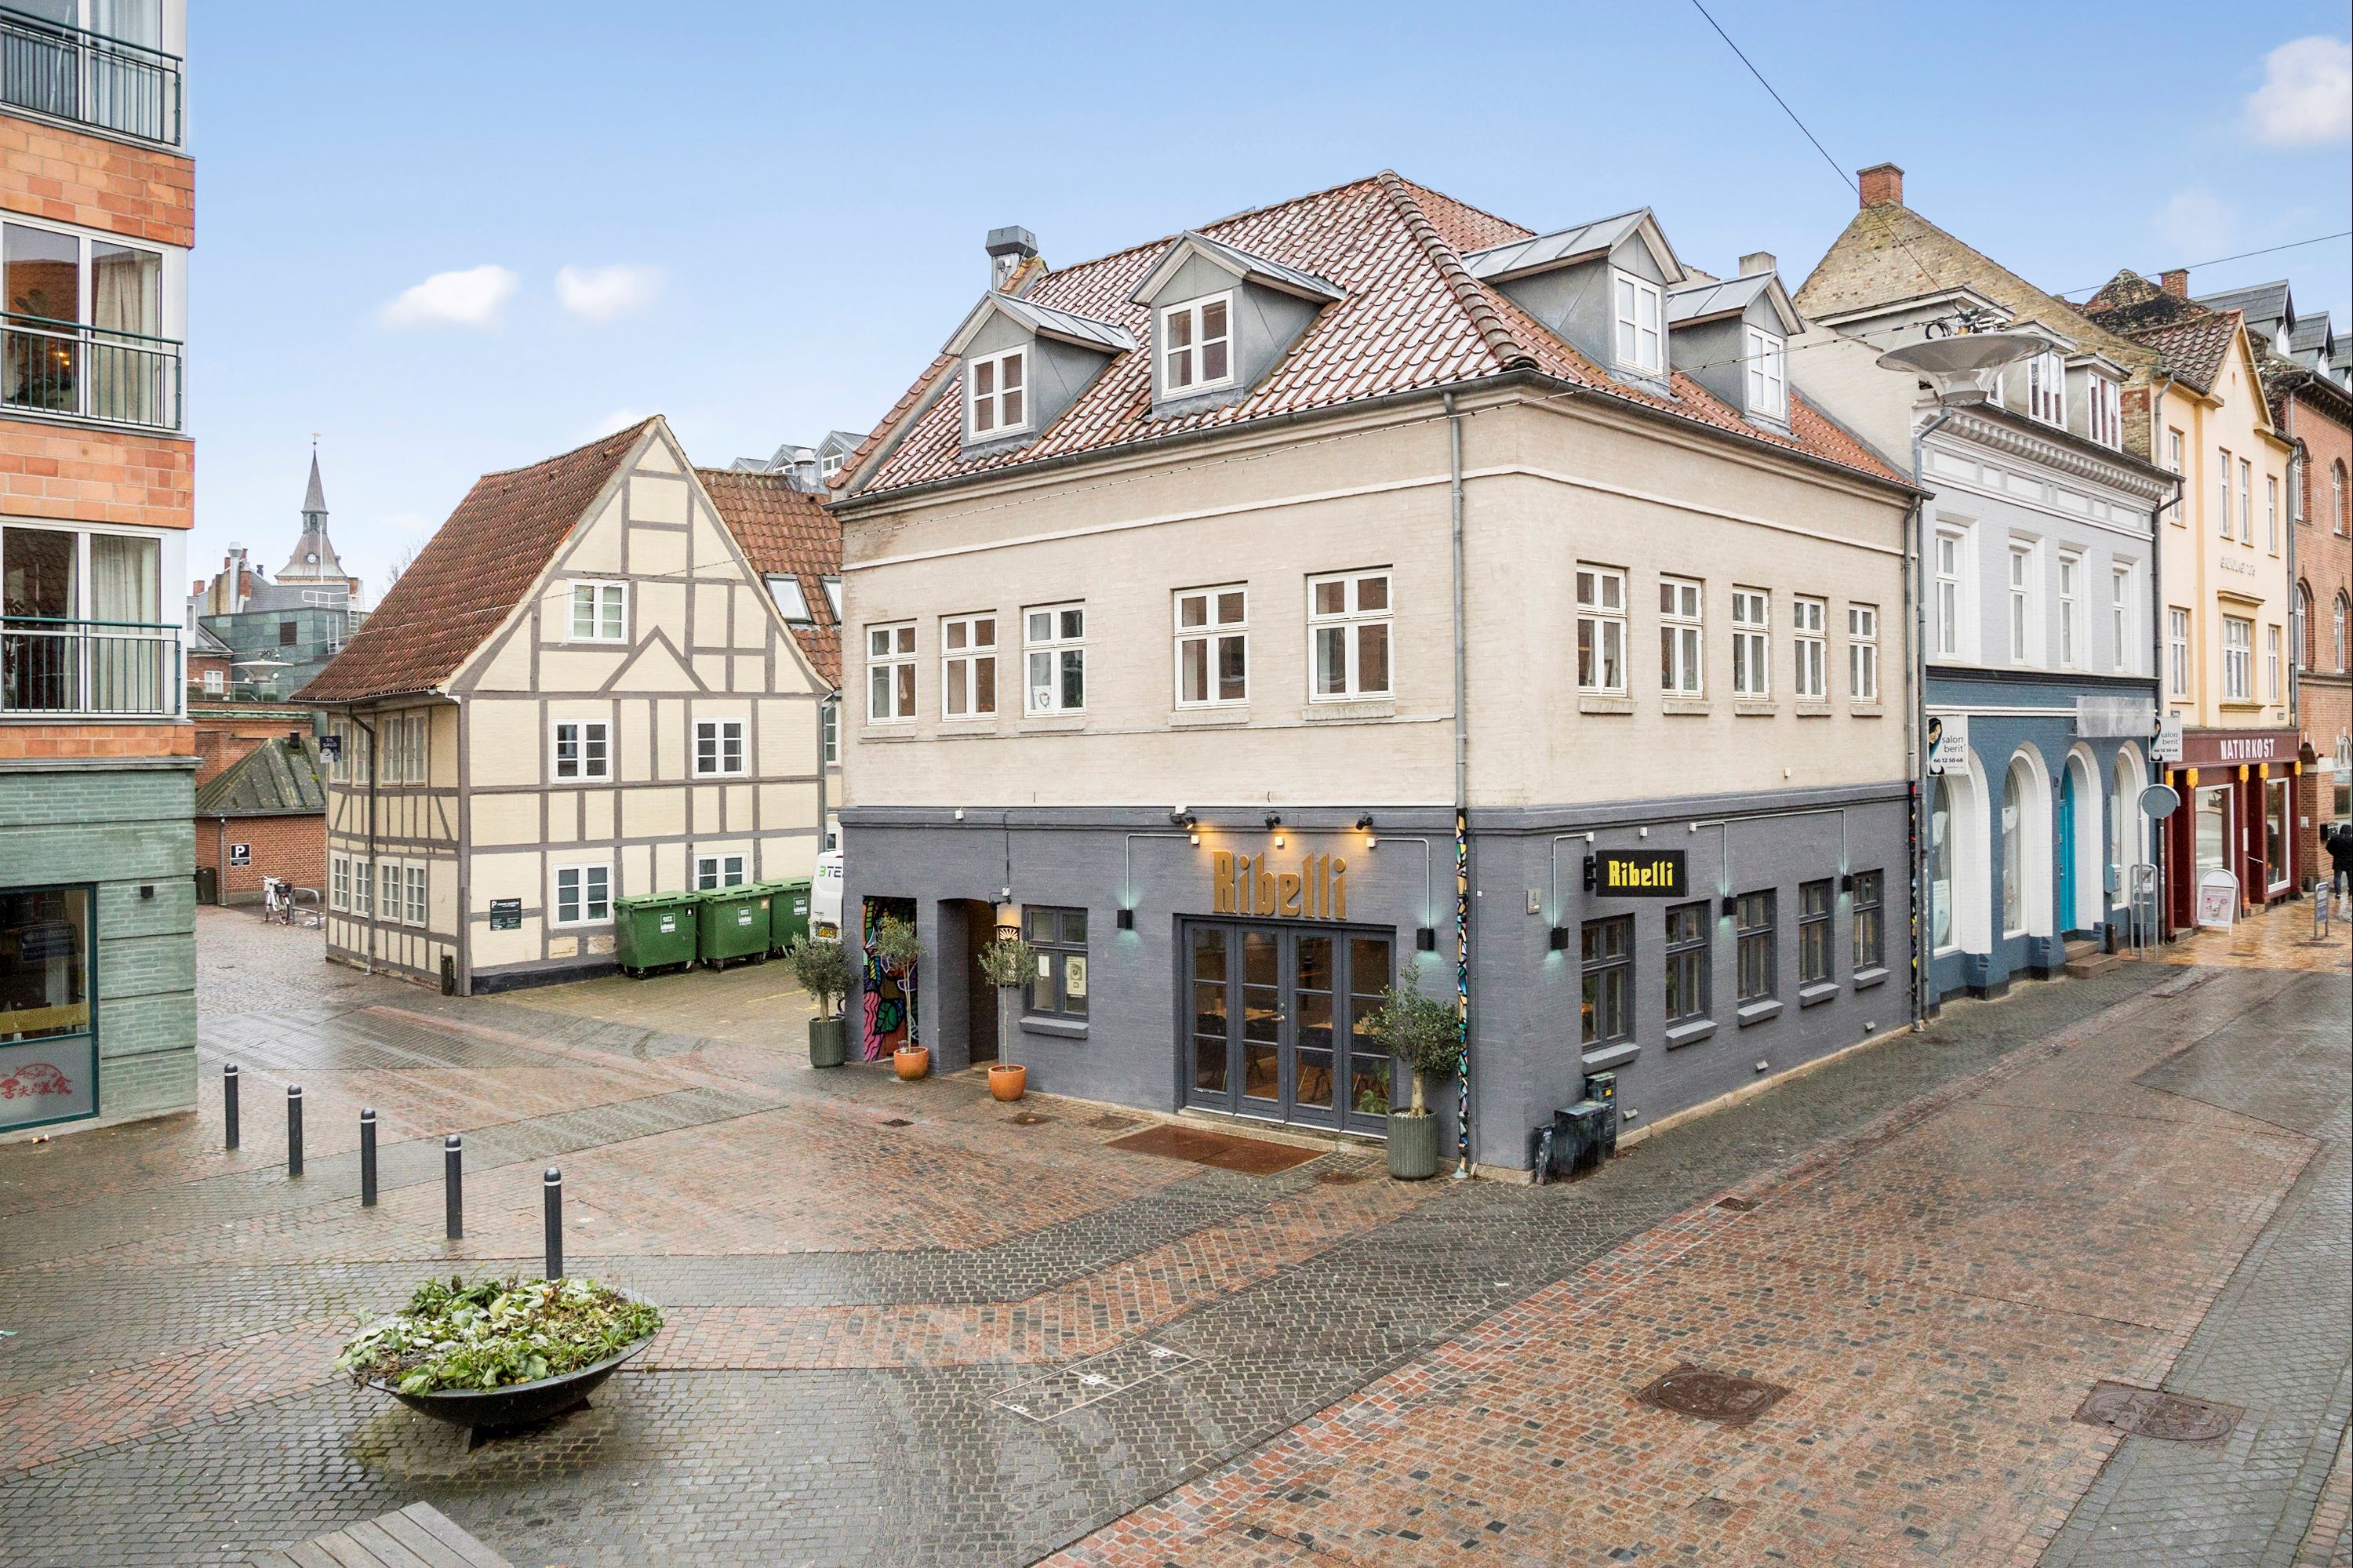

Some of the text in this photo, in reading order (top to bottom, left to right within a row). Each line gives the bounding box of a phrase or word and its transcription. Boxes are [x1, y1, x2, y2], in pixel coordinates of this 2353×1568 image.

[1941, 735, 1964, 744] salon
[1944, 744, 1964, 753] berit
[2220, 738, 2275, 760] NATURKOST
[235, 846, 245, 858] P
[1608, 860, 1674, 886] Ribelli
[1211, 849, 1347, 920] Ribelli
[491, 900, 497, 909] P
